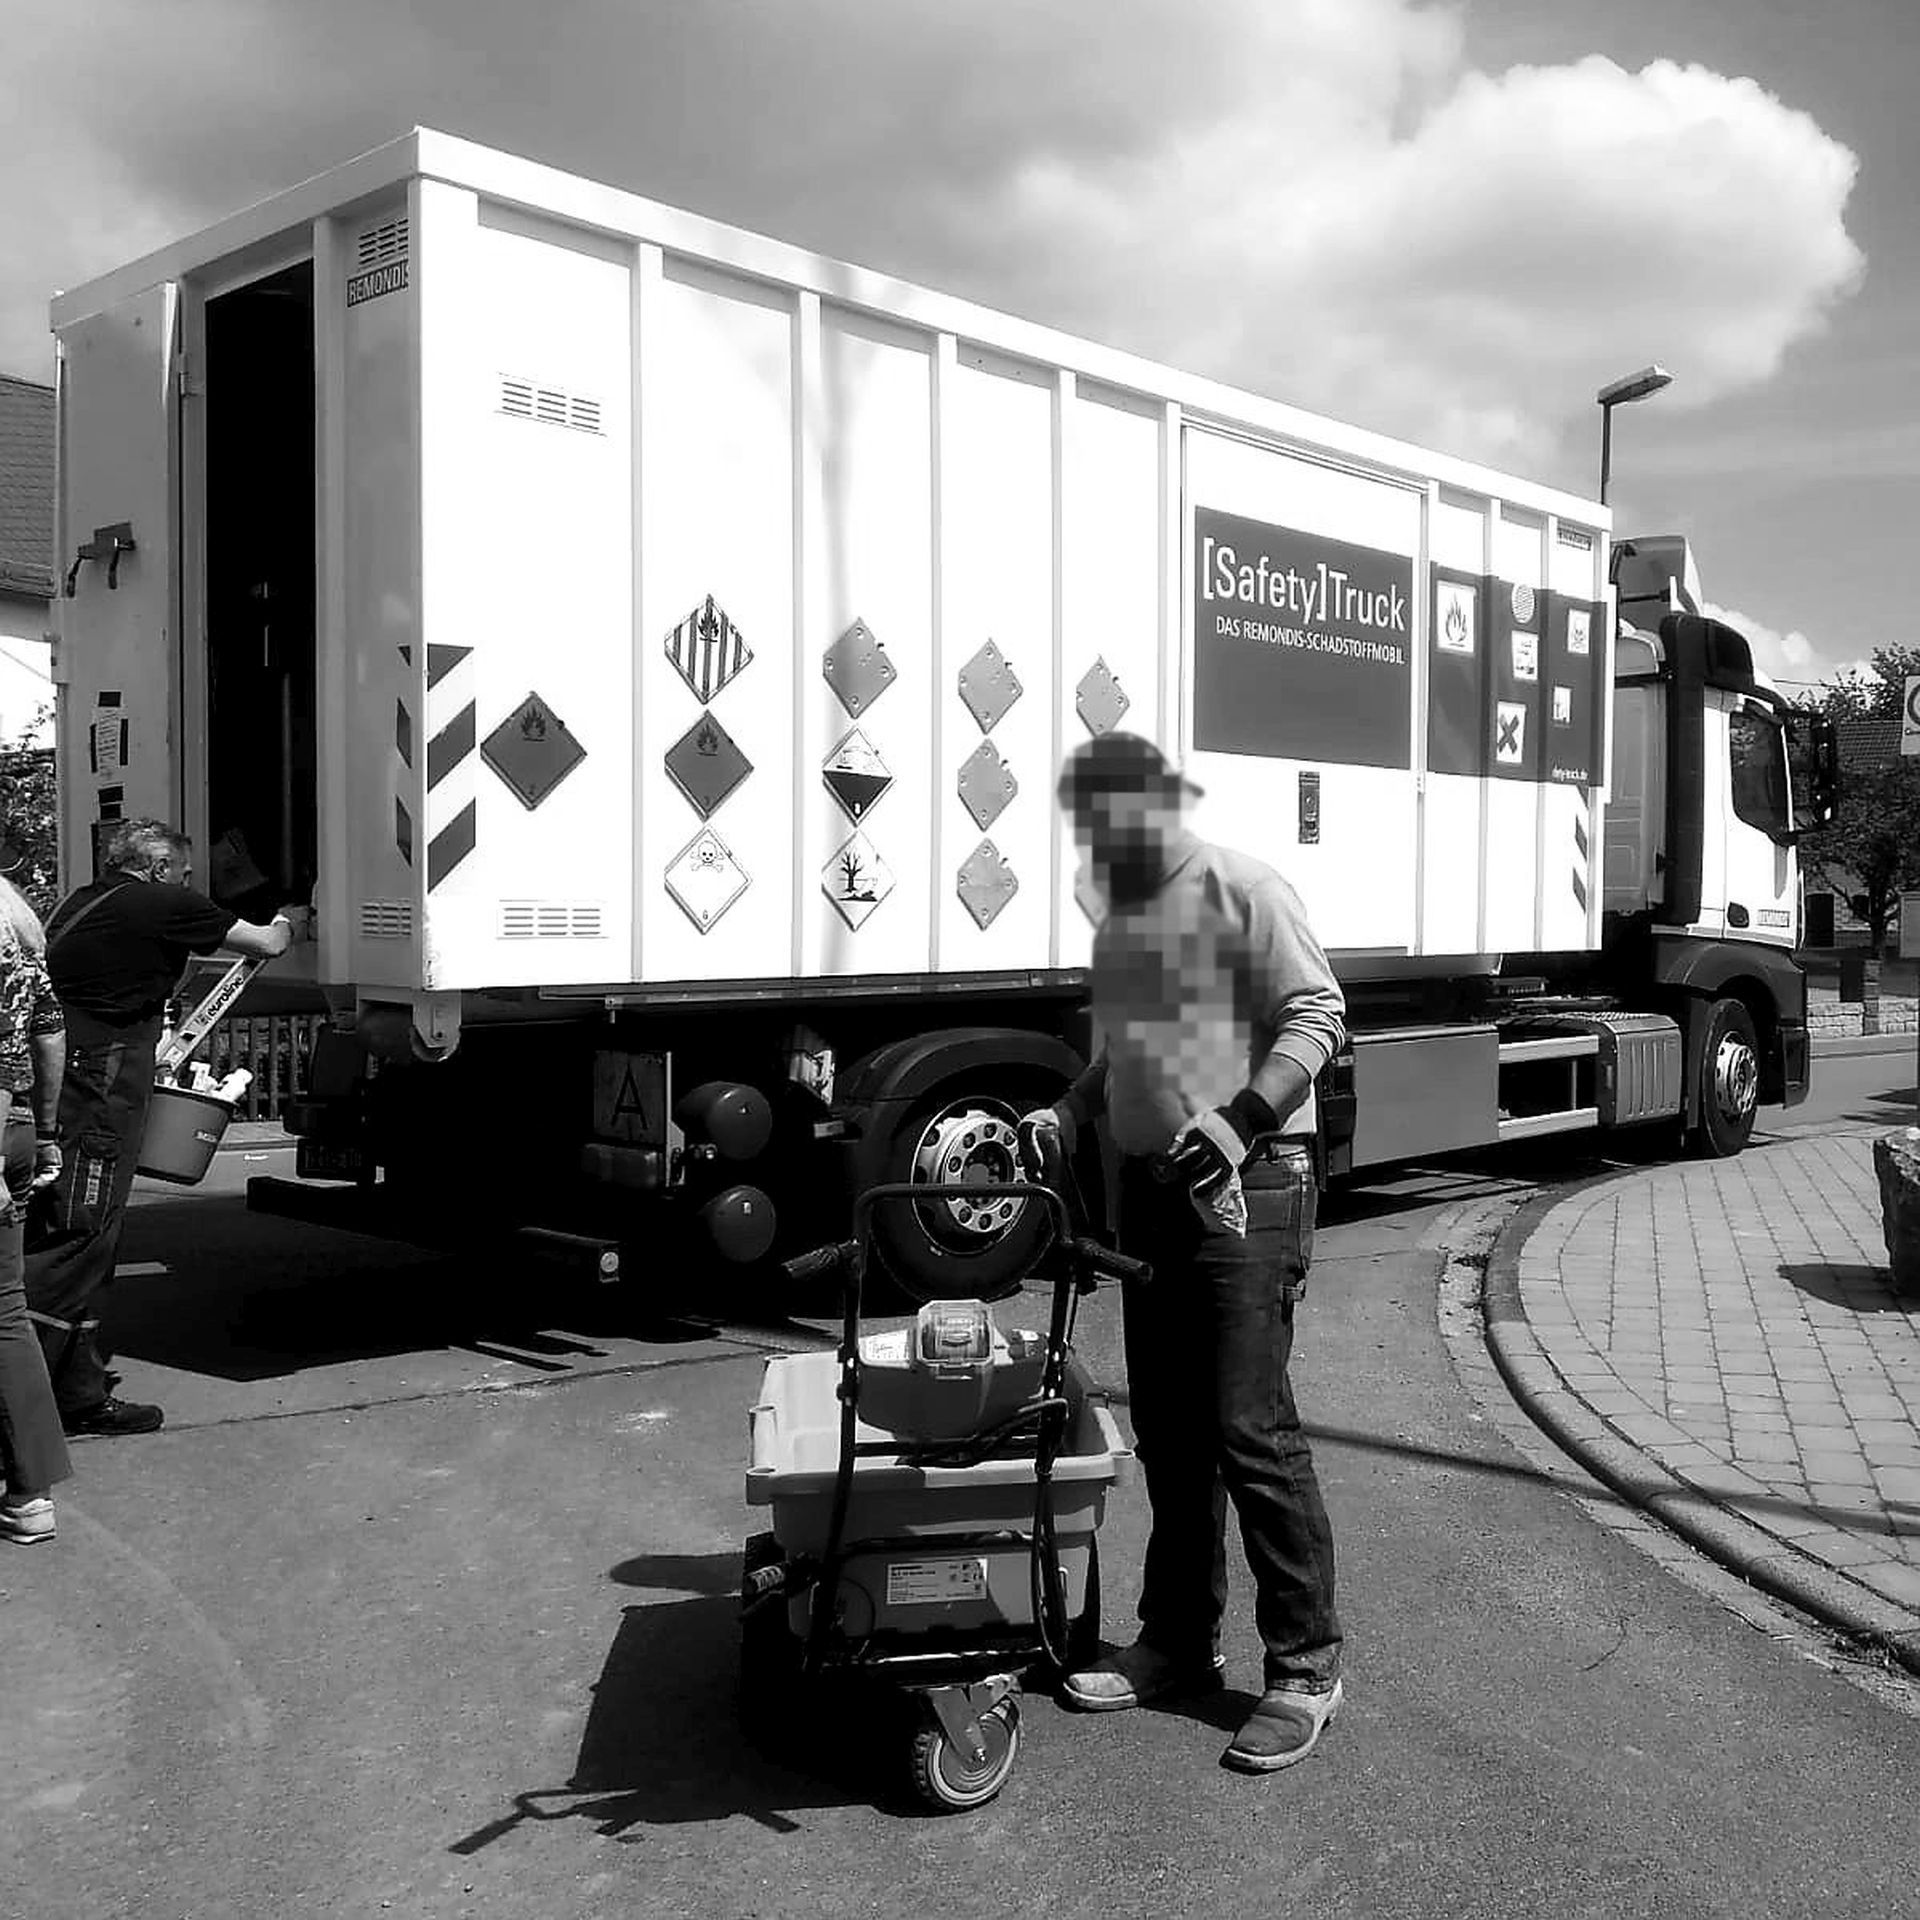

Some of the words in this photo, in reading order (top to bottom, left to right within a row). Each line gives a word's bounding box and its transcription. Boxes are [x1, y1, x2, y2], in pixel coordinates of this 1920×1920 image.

[1216, 615, 1240, 637] DAS
[1243, 620, 1405, 665] REMONDIS-SCHADSTOFFMOBIL
[610, 1062, 650, 1131] A
